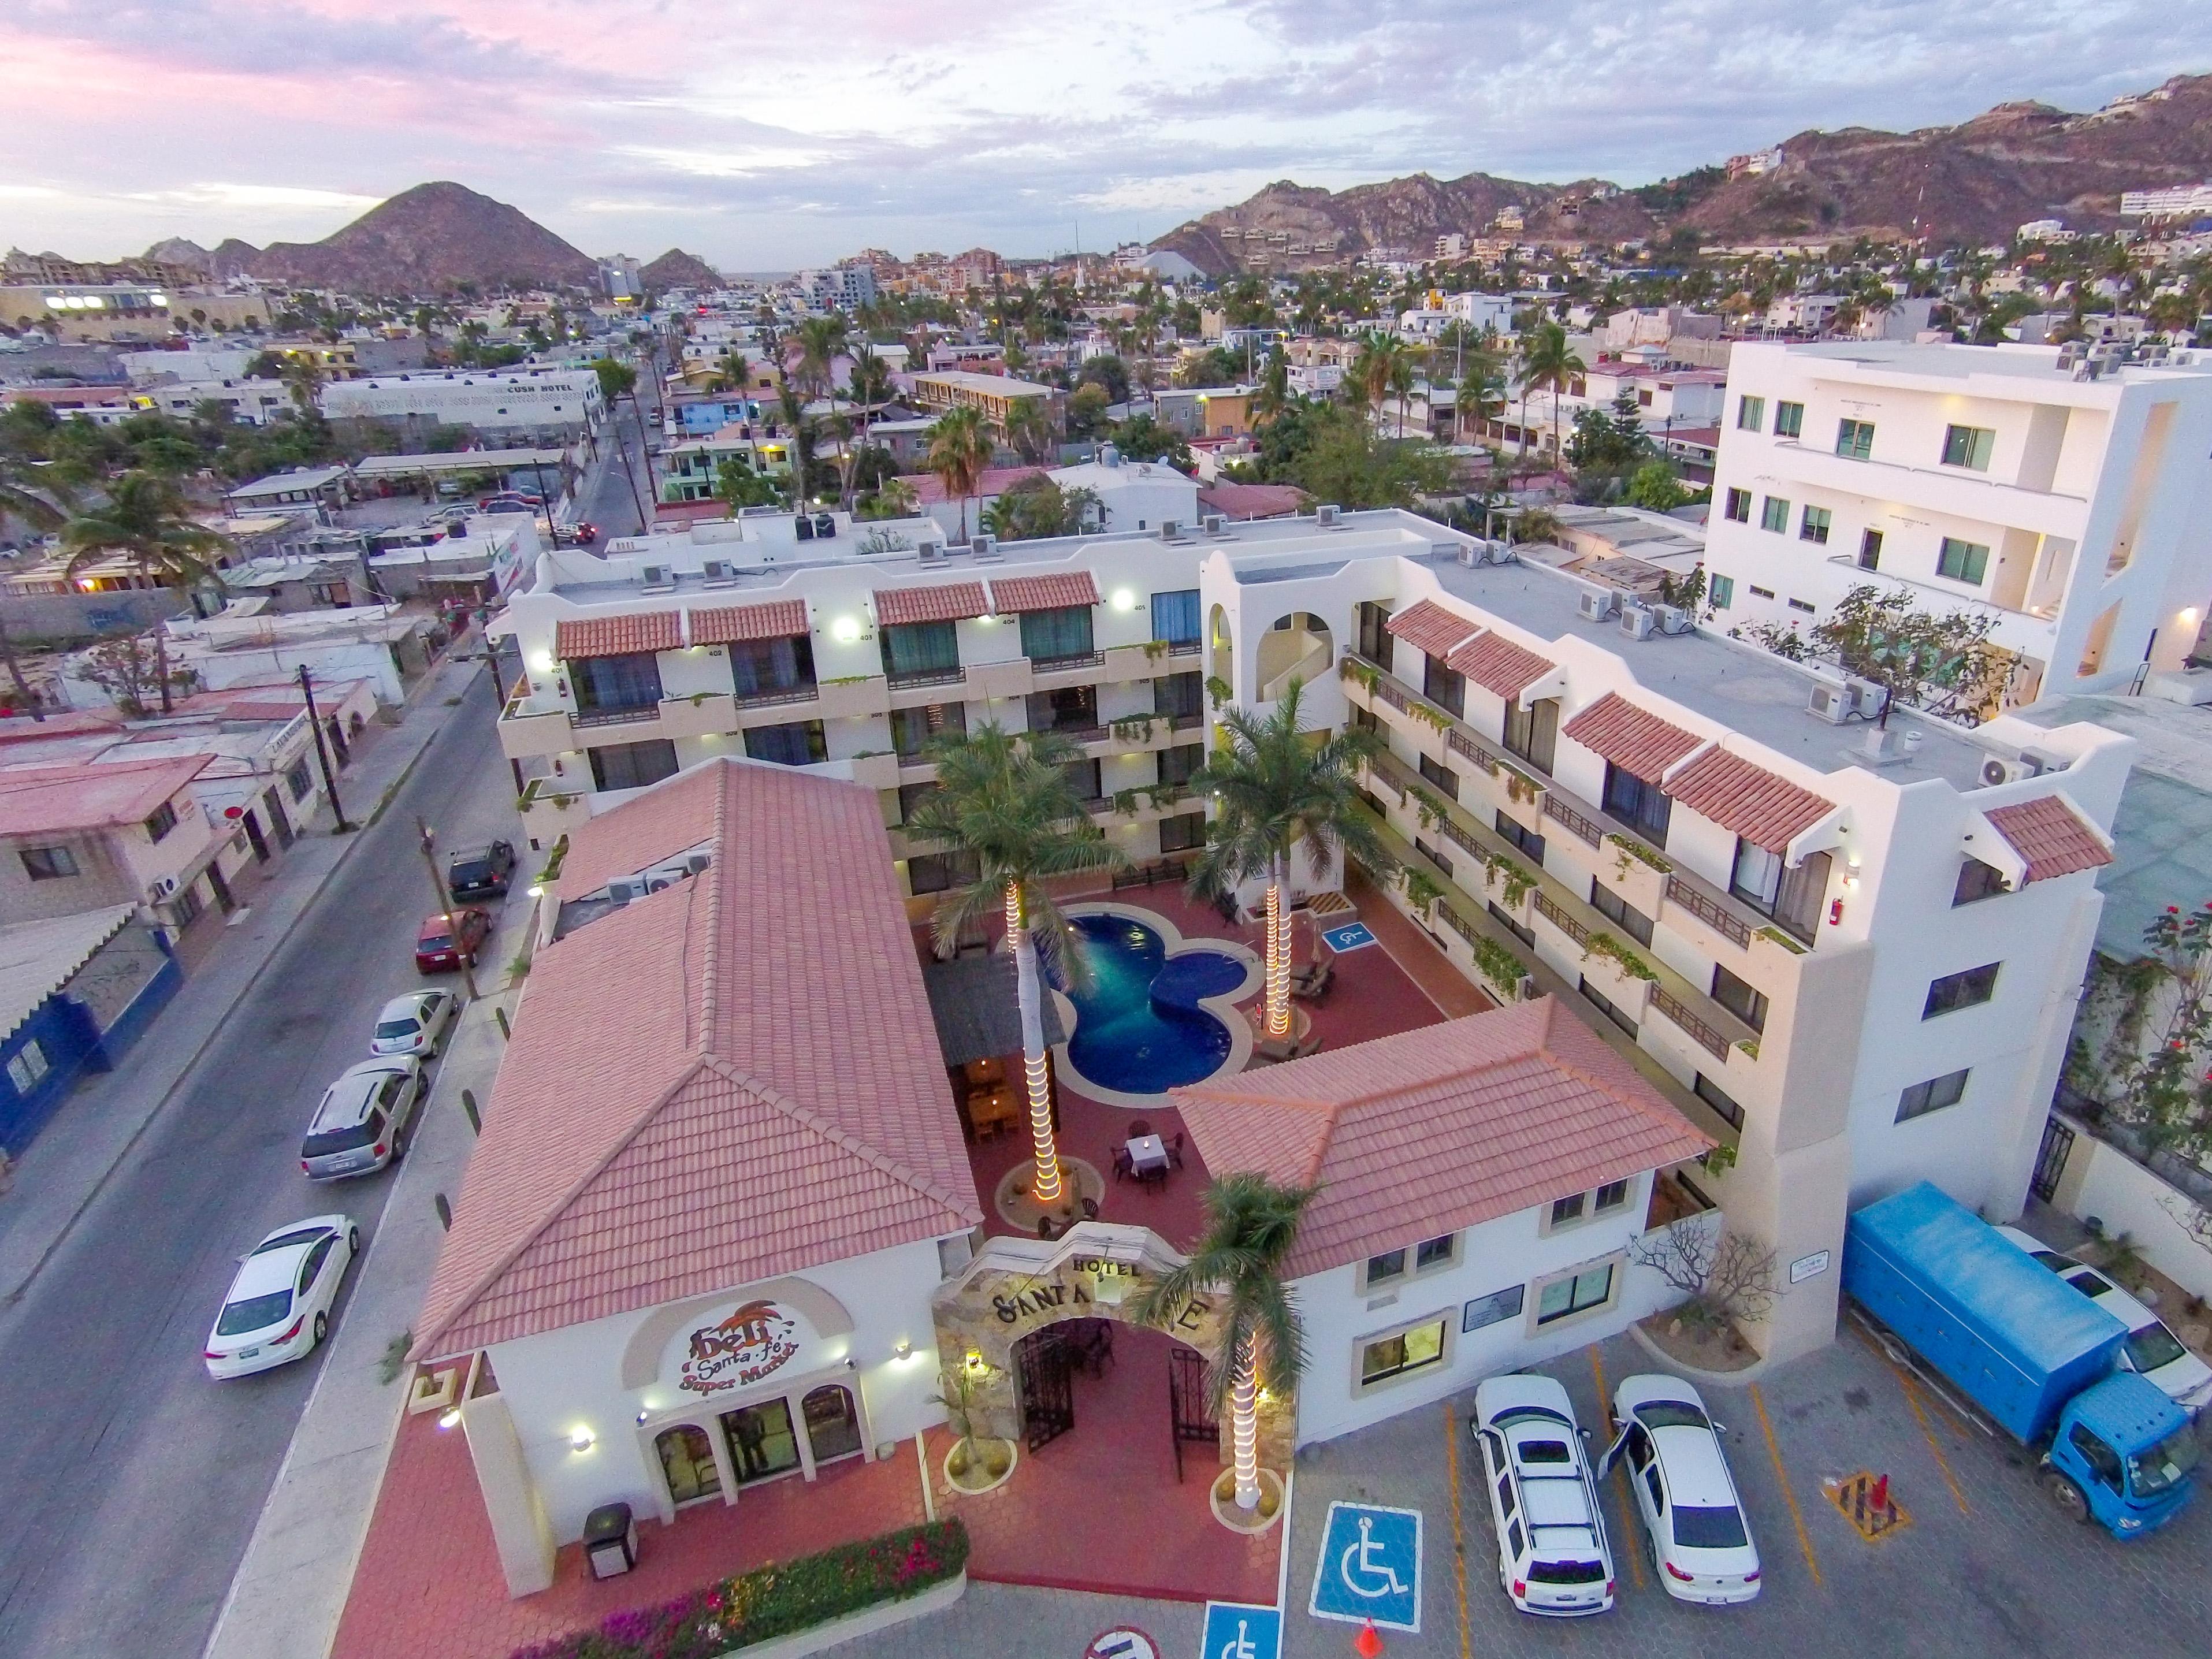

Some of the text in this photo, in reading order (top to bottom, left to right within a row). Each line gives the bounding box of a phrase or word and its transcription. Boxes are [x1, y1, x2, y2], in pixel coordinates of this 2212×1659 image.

[1073, 1259, 1141, 1277] HOTEL
[992, 1283, 1091, 1323] SANTA
[697, 1351, 751, 1381] Santa
[679, 1375, 736, 1397] Super
